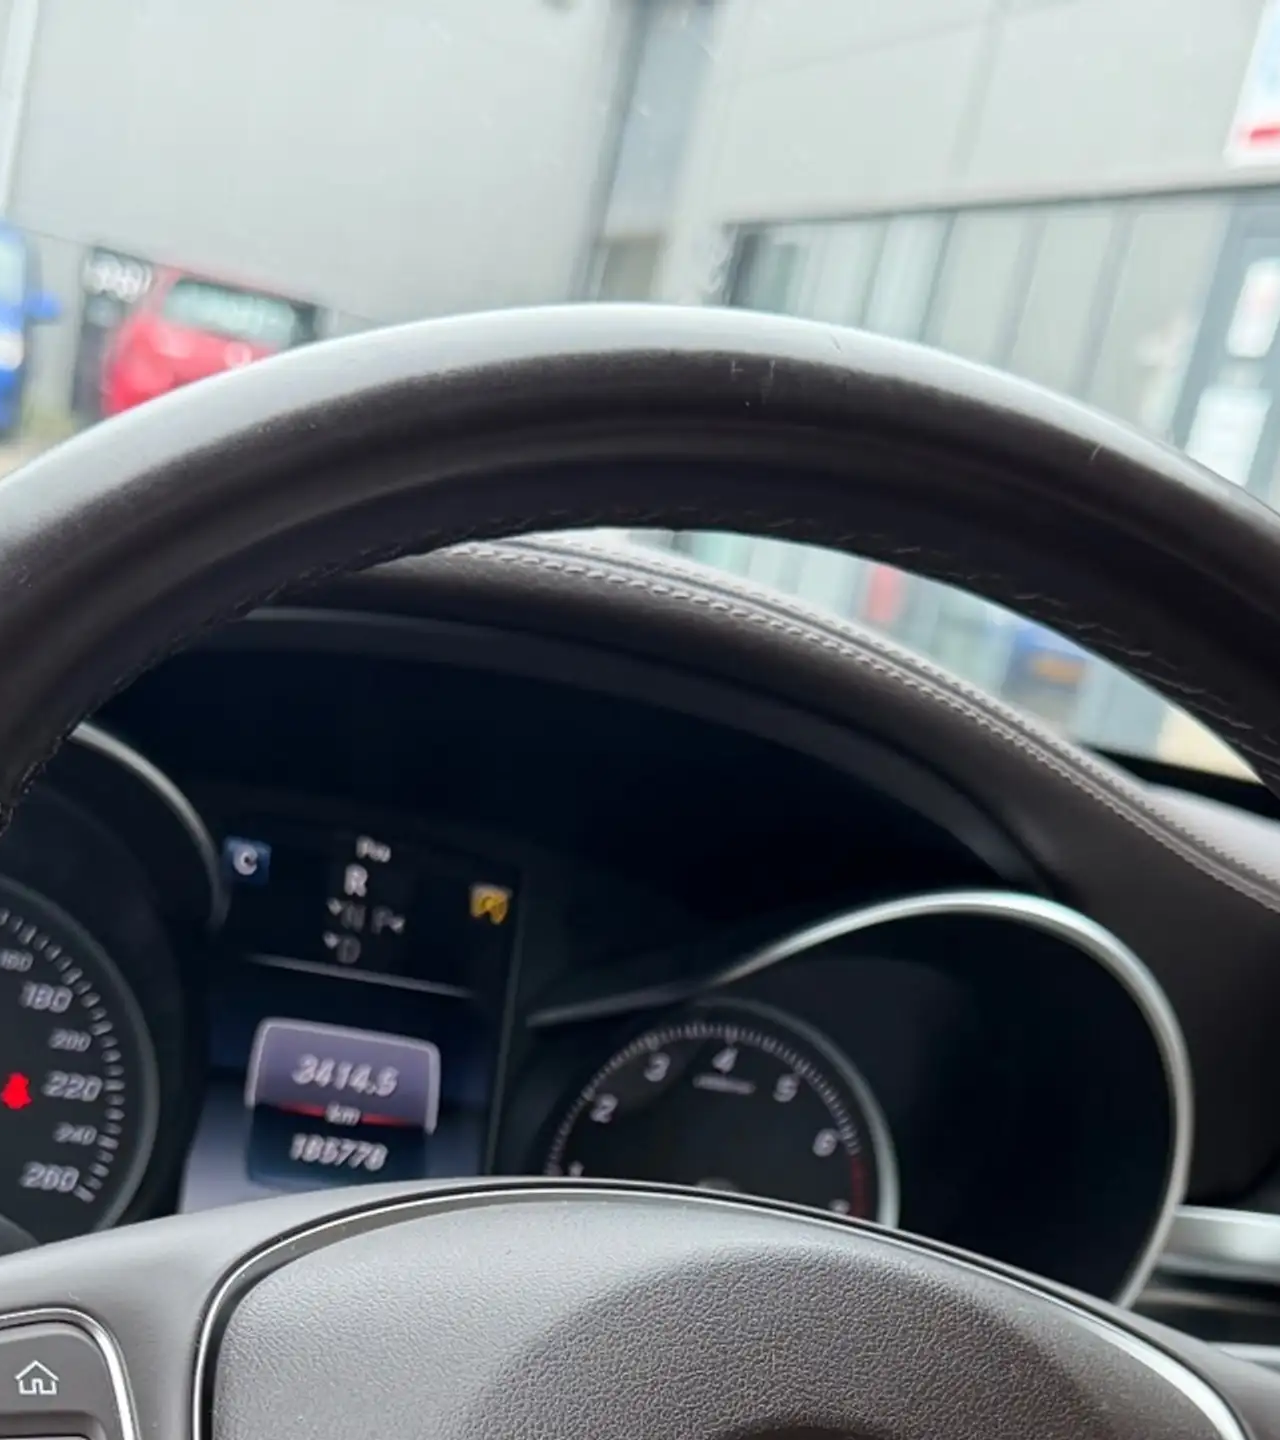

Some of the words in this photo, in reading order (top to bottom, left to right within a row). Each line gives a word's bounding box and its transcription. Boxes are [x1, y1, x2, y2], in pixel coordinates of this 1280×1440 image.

[344, 863, 369, 897] R
[20, 981, 74, 1014] 180
[48, 1027, 92, 1053] 200
[643, 1052, 671, 1083] 3
[41, 1070, 104, 1102] 220
[589, 1092, 619, 1124] 2
[52, 1121, 98, 1146] 240
[20, 1160, 80, 1193] 260
